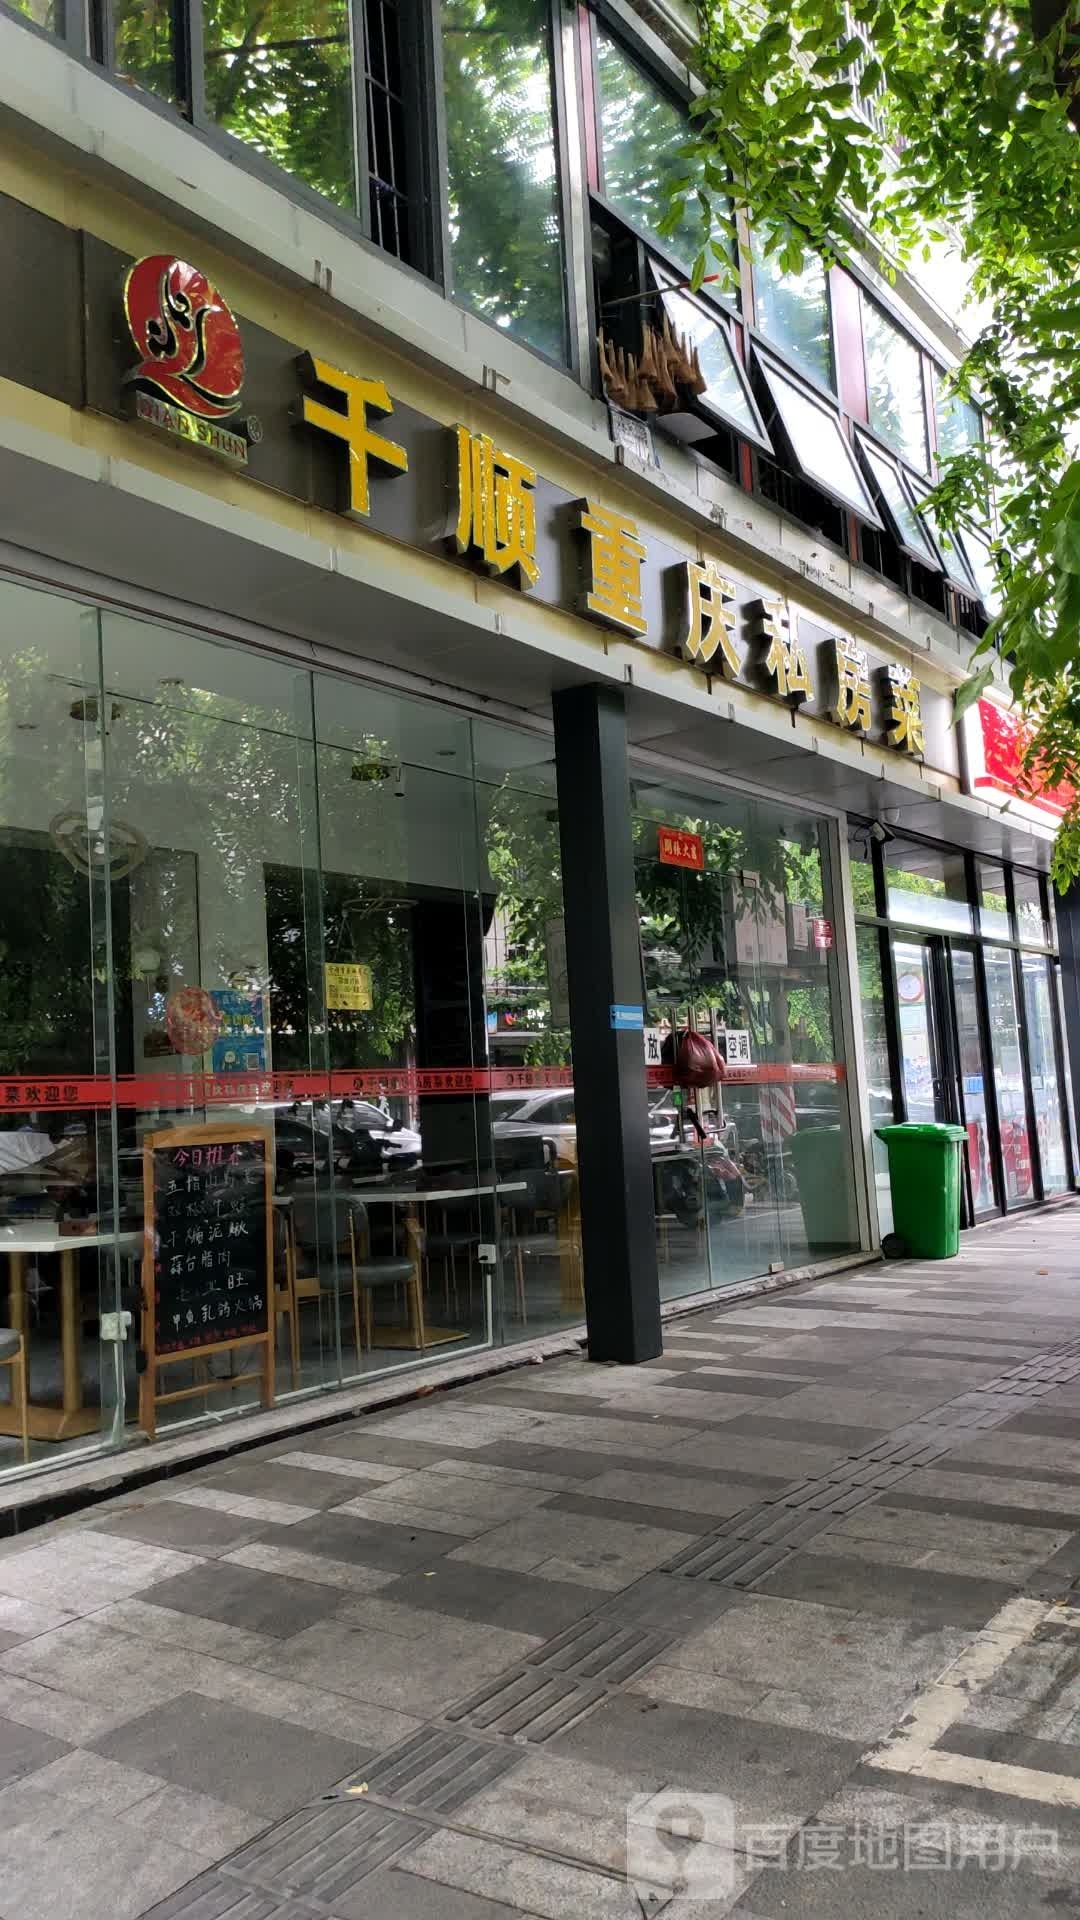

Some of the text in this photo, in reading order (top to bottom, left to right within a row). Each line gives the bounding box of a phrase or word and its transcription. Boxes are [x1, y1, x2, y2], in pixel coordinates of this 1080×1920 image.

[139, 395, 247, 460] QIAN SHUN
[303, 357, 923, 755] 千顺重庆私房菜
[727, 1034, 750, 1060] 空调
[5, 1086, 79, 1103] 菜欢迎您
[173, 1144, 241, 1168] 今日推荐
